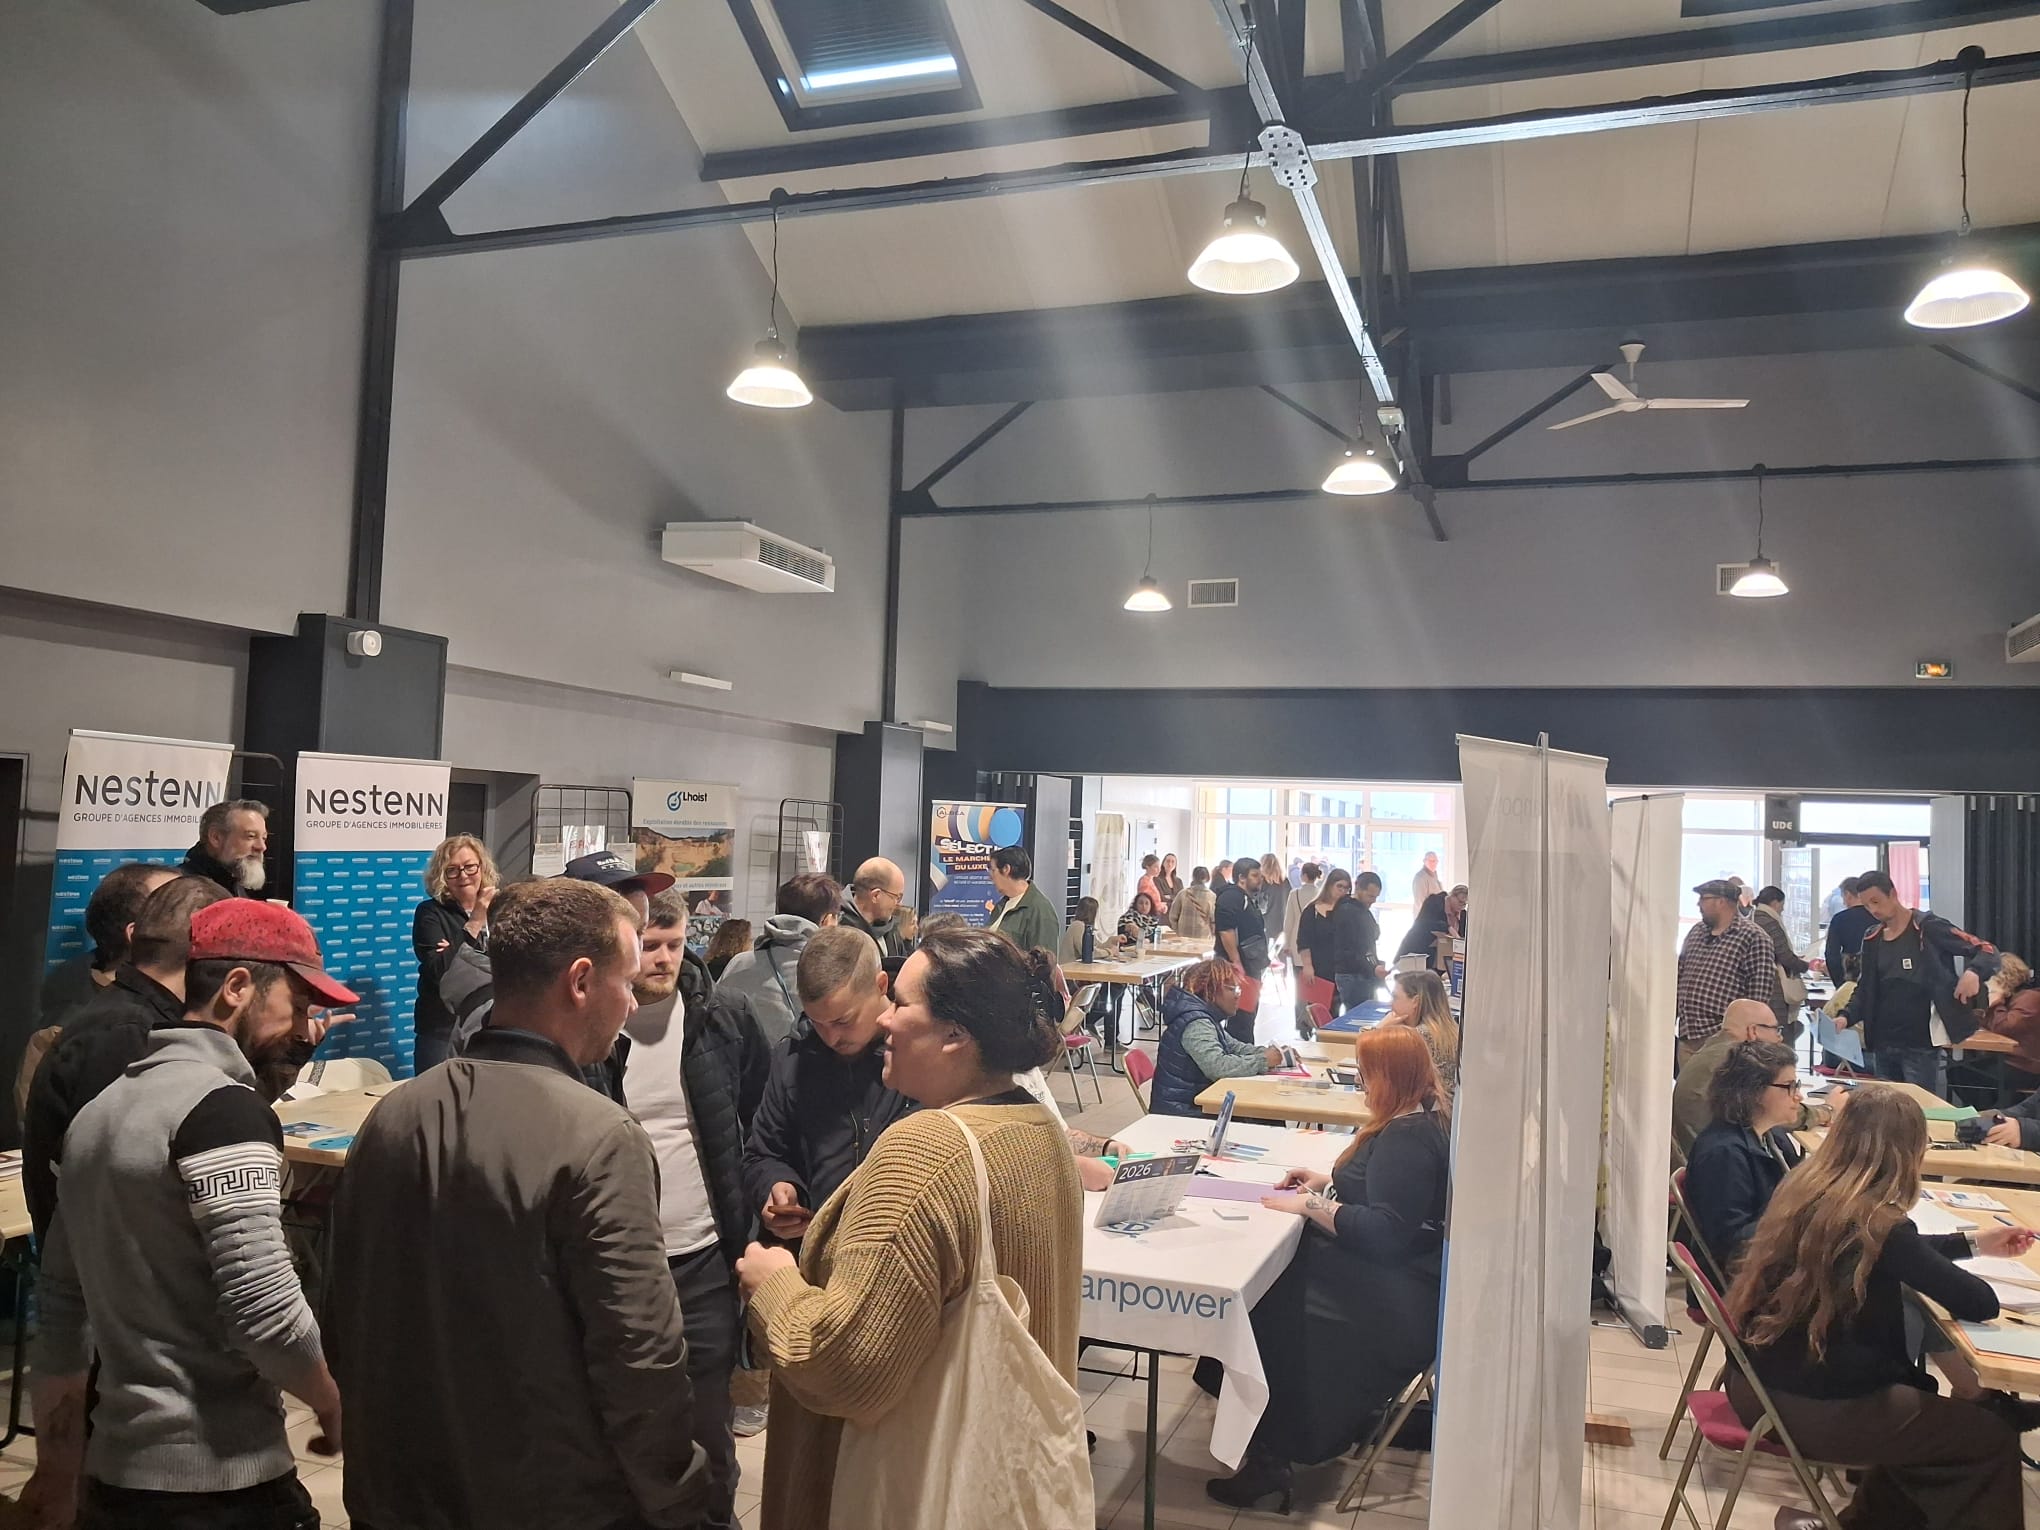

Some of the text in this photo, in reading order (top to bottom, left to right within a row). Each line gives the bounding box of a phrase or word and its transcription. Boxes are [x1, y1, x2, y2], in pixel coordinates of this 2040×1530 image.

[682, 791, 707, 802] Lhoist
[73, 812, 201, 824] GROUPE D'AGENCES IMMOBIL
[306, 820, 442, 830] GROUPE D'AGENCES IMMOBILIÈRES
[940, 838, 1004, 855] SÉLECT
[1119, 1163, 1153, 1180] 2026
[1081, 1274, 1232, 1320] anpower
